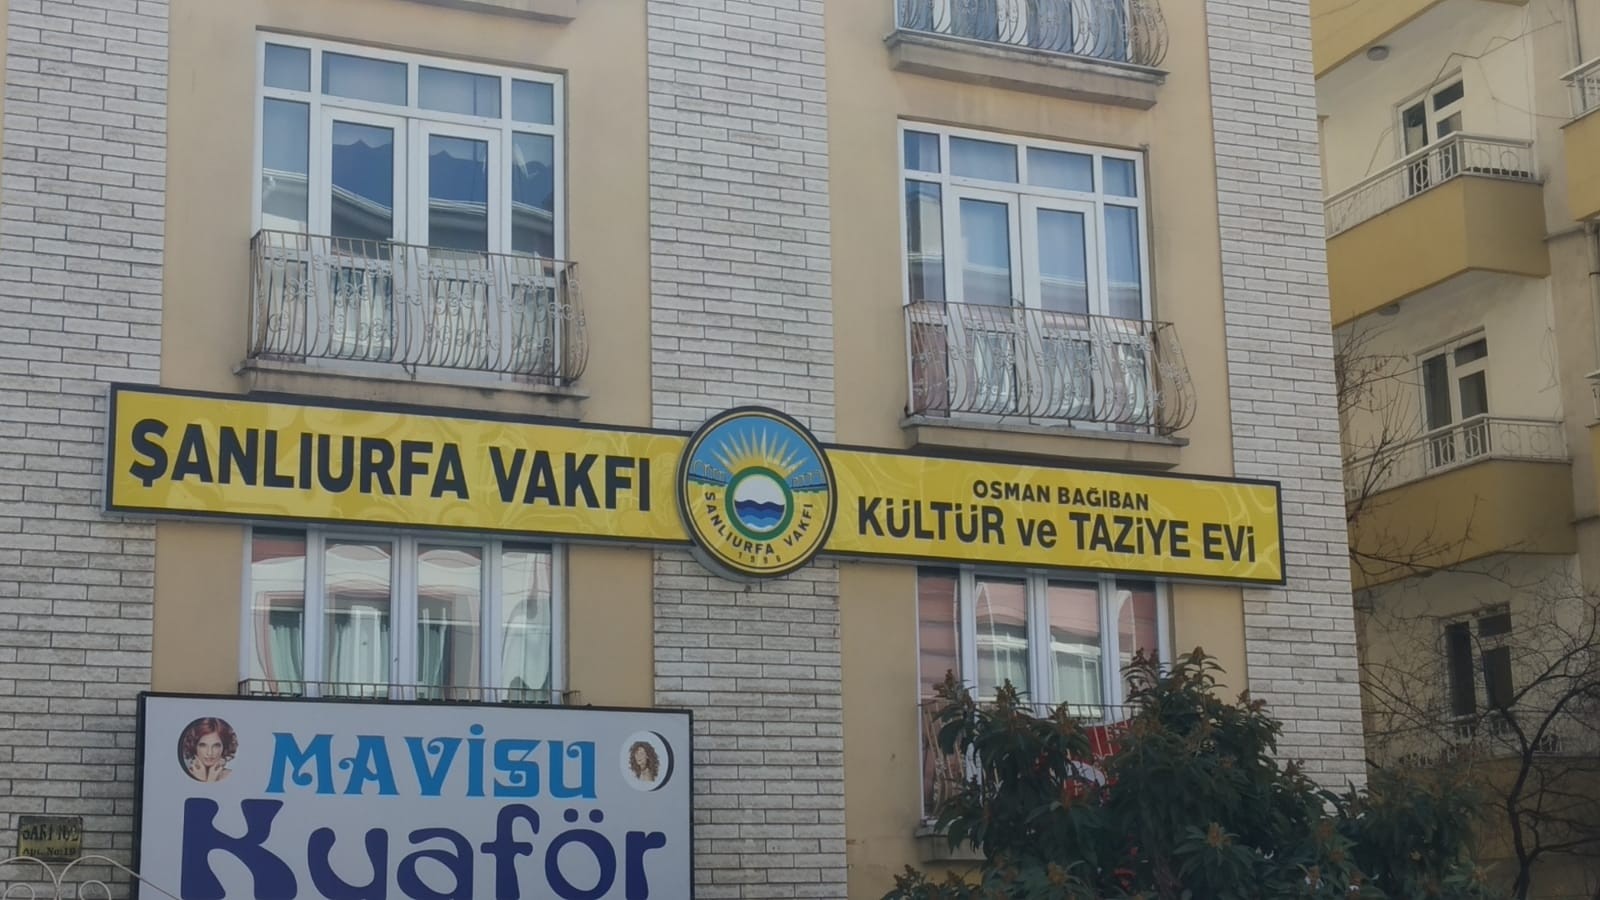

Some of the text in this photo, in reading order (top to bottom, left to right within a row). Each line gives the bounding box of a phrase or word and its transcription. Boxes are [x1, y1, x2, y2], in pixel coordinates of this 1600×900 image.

[129, 419, 650, 511] ŞANLIURFA VAKFI
[973, 480, 1149, 511] OSMAN BAĞIBAN
[783, 504, 814, 547] VAKFI
[858, 497, 1256, 562] KÜLTÜR ve TAZİYE EVİ
